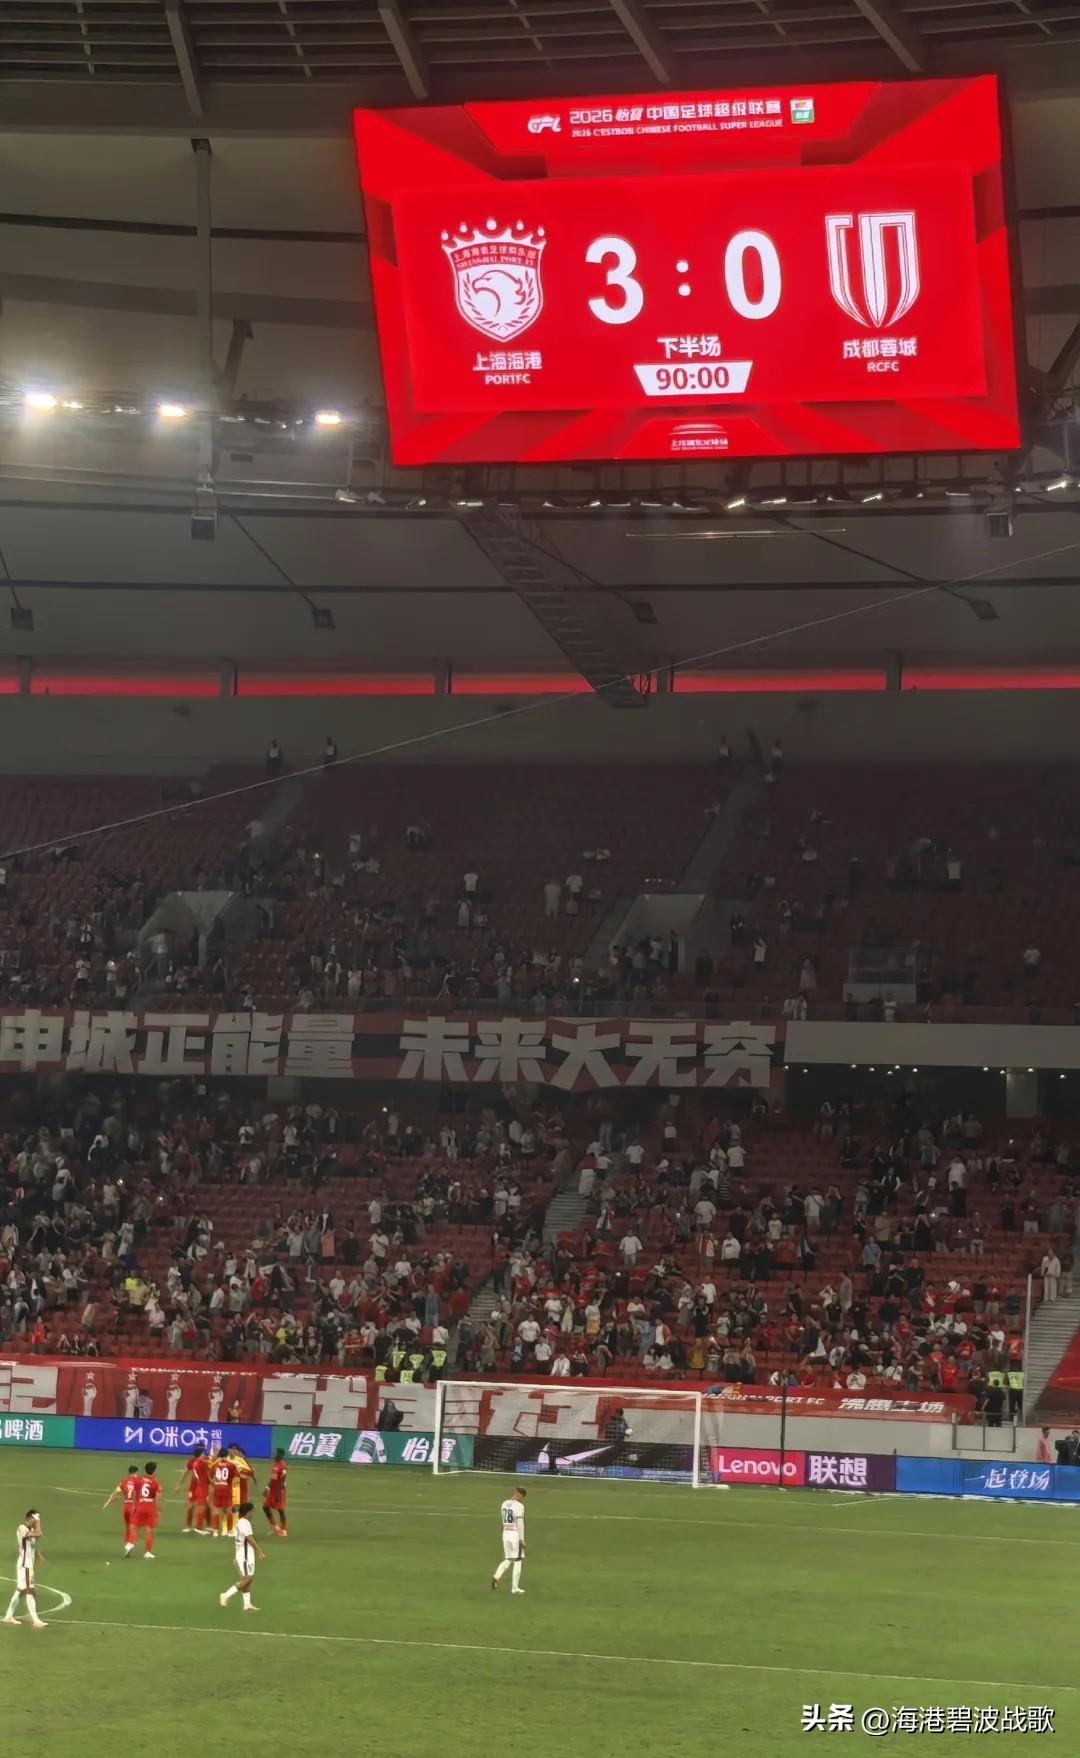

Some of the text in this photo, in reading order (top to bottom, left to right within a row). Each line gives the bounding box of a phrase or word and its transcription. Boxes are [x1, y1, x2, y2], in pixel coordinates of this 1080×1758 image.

[569, 109, 613, 124] 2026
[646, 100, 781, 120] 中国足球超级联赛
[637, 124, 672, 134] CHINESE
[673, 123, 718, 132] FOOTBALL
[720, 121, 747, 130] SUPER
[749, 119, 782, 128] LEAGUE
[585, 236, 644, 325] 3
[724, 229, 782, 320] 0
[656, 334, 721, 359] 下半场
[843, 337, 918, 359] 成都蓉城
[472, 351, 543, 372] 上海海港
[867, 361, 900, 373] RCFC
[485, 374, 532, 385] PORTFC
[655, 366, 730, 391] 90:00
[0, 1419, 44, 1441] 啤酒
[215, 1466, 229, 1481] 40
[718, 1454, 798, 1477] Lenovo
[808, 1454, 868, 1487] 联想
[141, 1483, 151, 1498] 6
